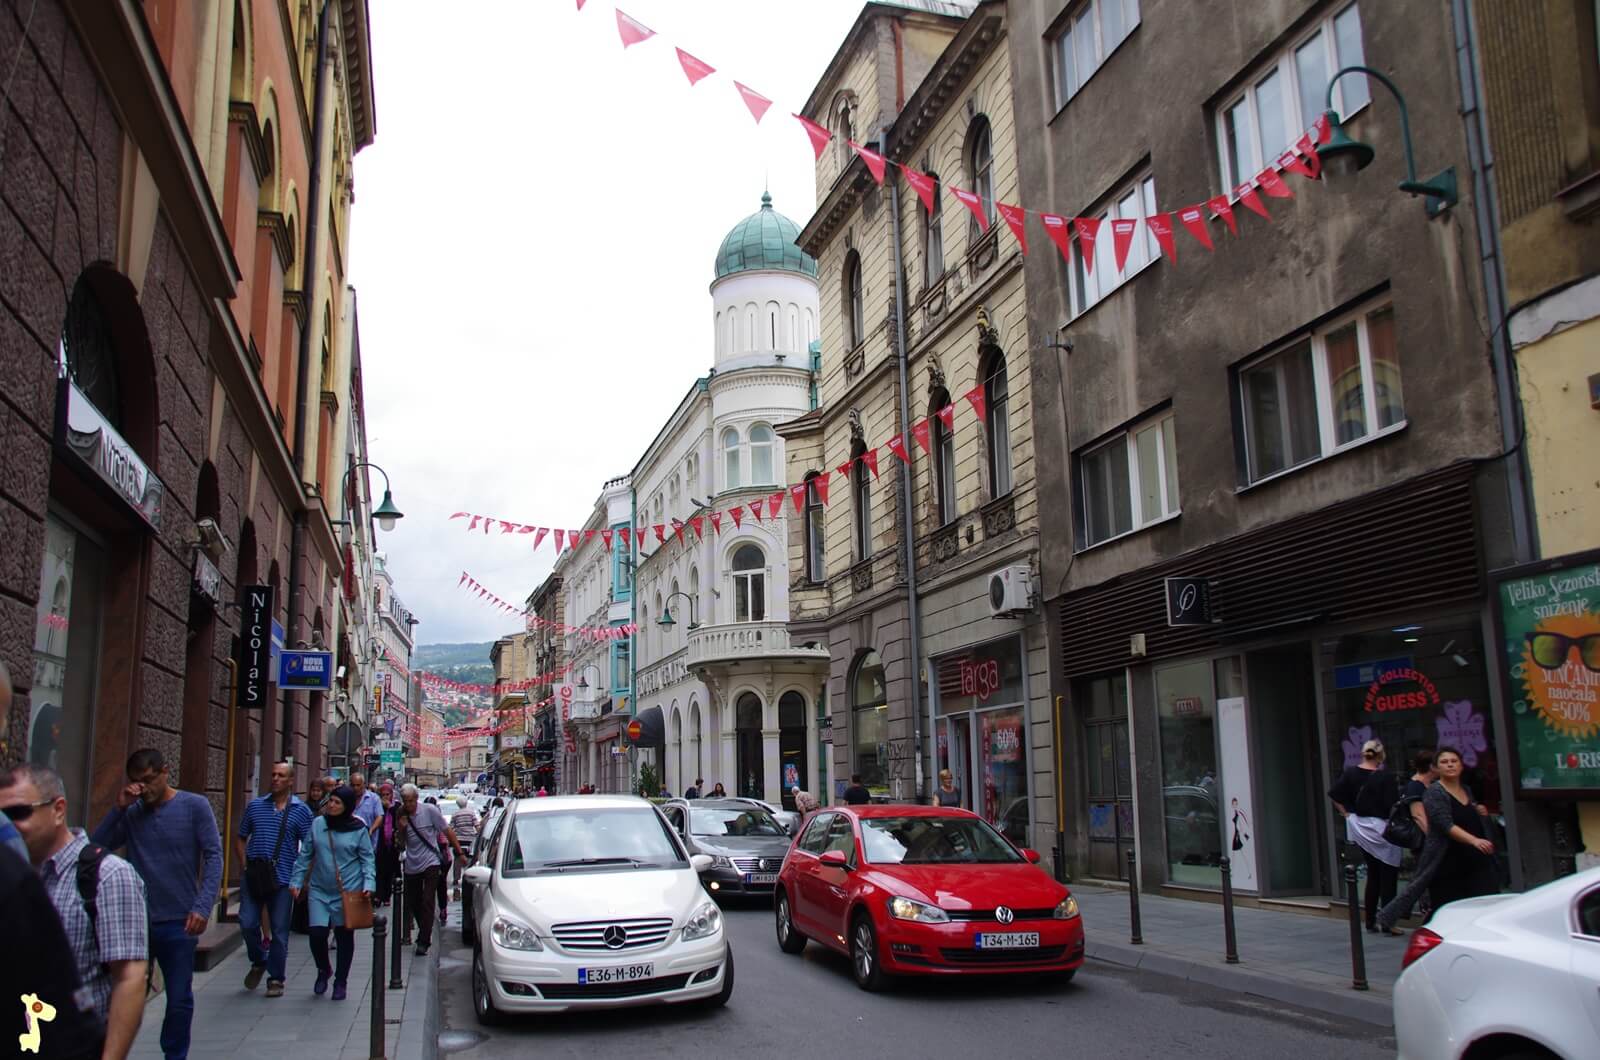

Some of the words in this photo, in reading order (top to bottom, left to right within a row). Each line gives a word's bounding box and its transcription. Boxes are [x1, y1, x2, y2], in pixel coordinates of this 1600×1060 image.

[1507, 579, 1546, 606] Veliko
[957, 658, 999, 700] Targa
[1375, 691, 1429, 713] GUESS
[983, 934, 1038, 946] T34-M-165
[587, 964, 651, 983] E36-M-894
